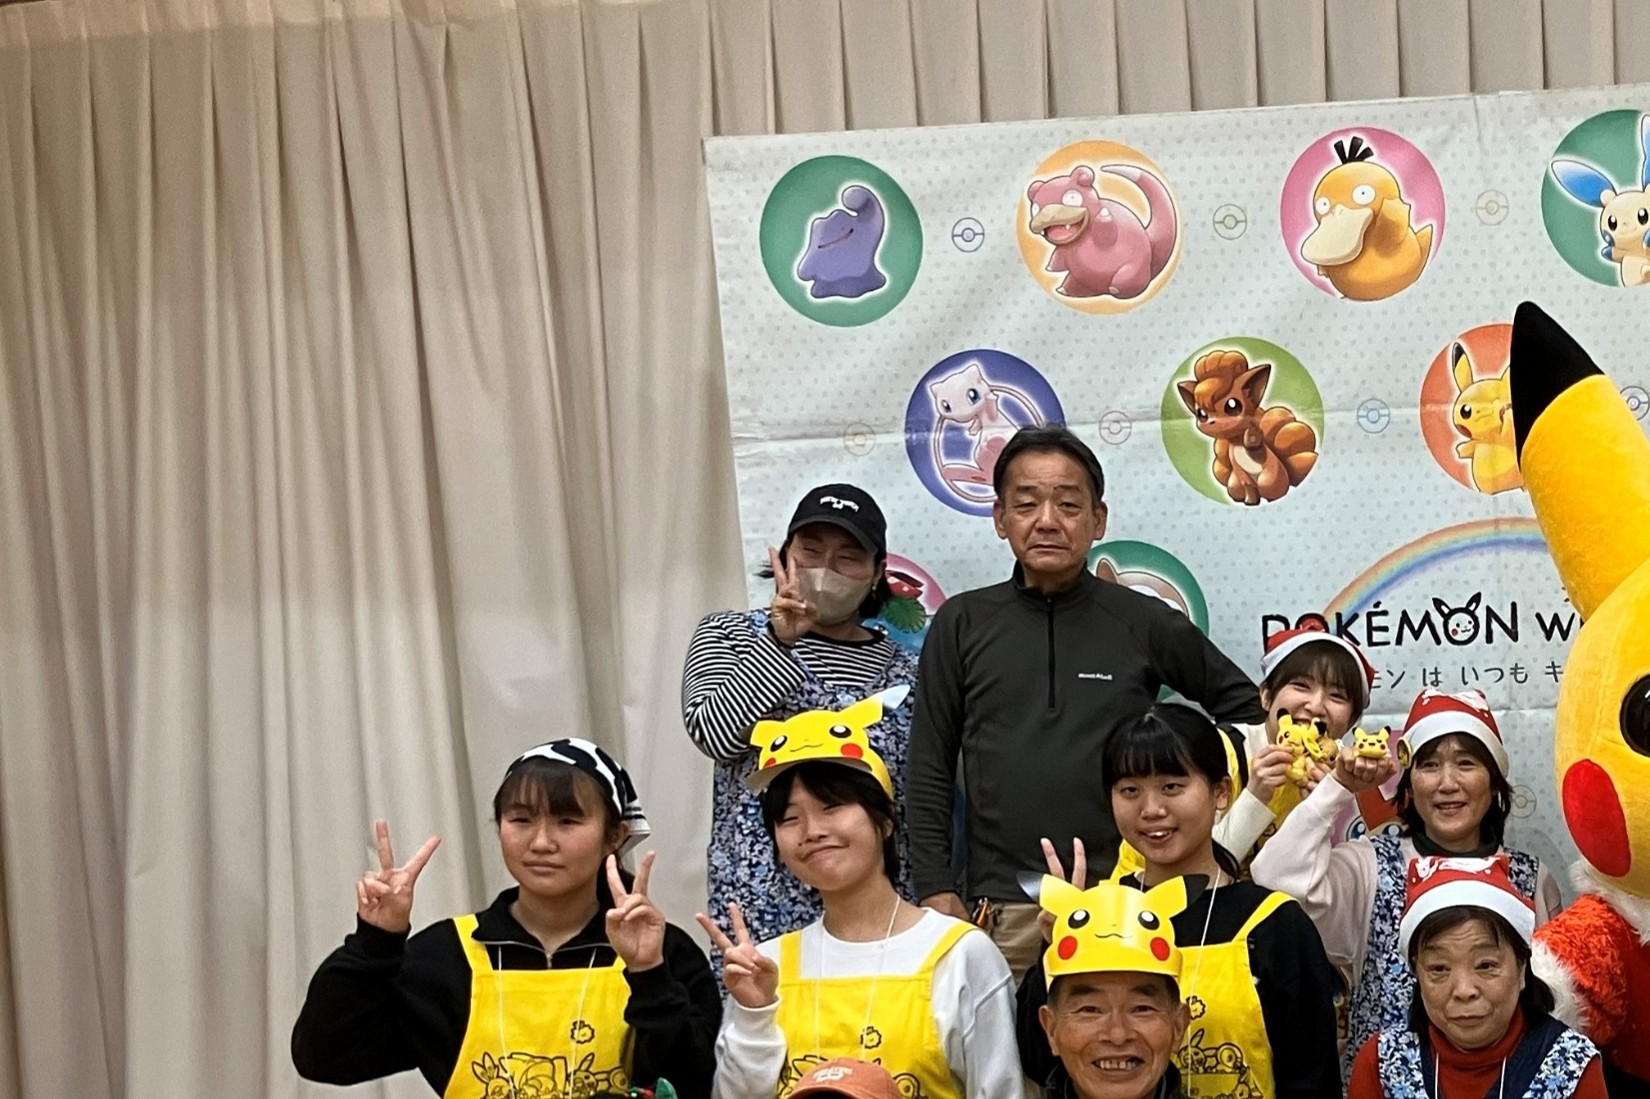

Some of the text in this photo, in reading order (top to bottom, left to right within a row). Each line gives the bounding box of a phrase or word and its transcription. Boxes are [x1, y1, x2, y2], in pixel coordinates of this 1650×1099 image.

[1422, 666, 1443, 688] は
[1461, 662, 1528, 686] いつも
